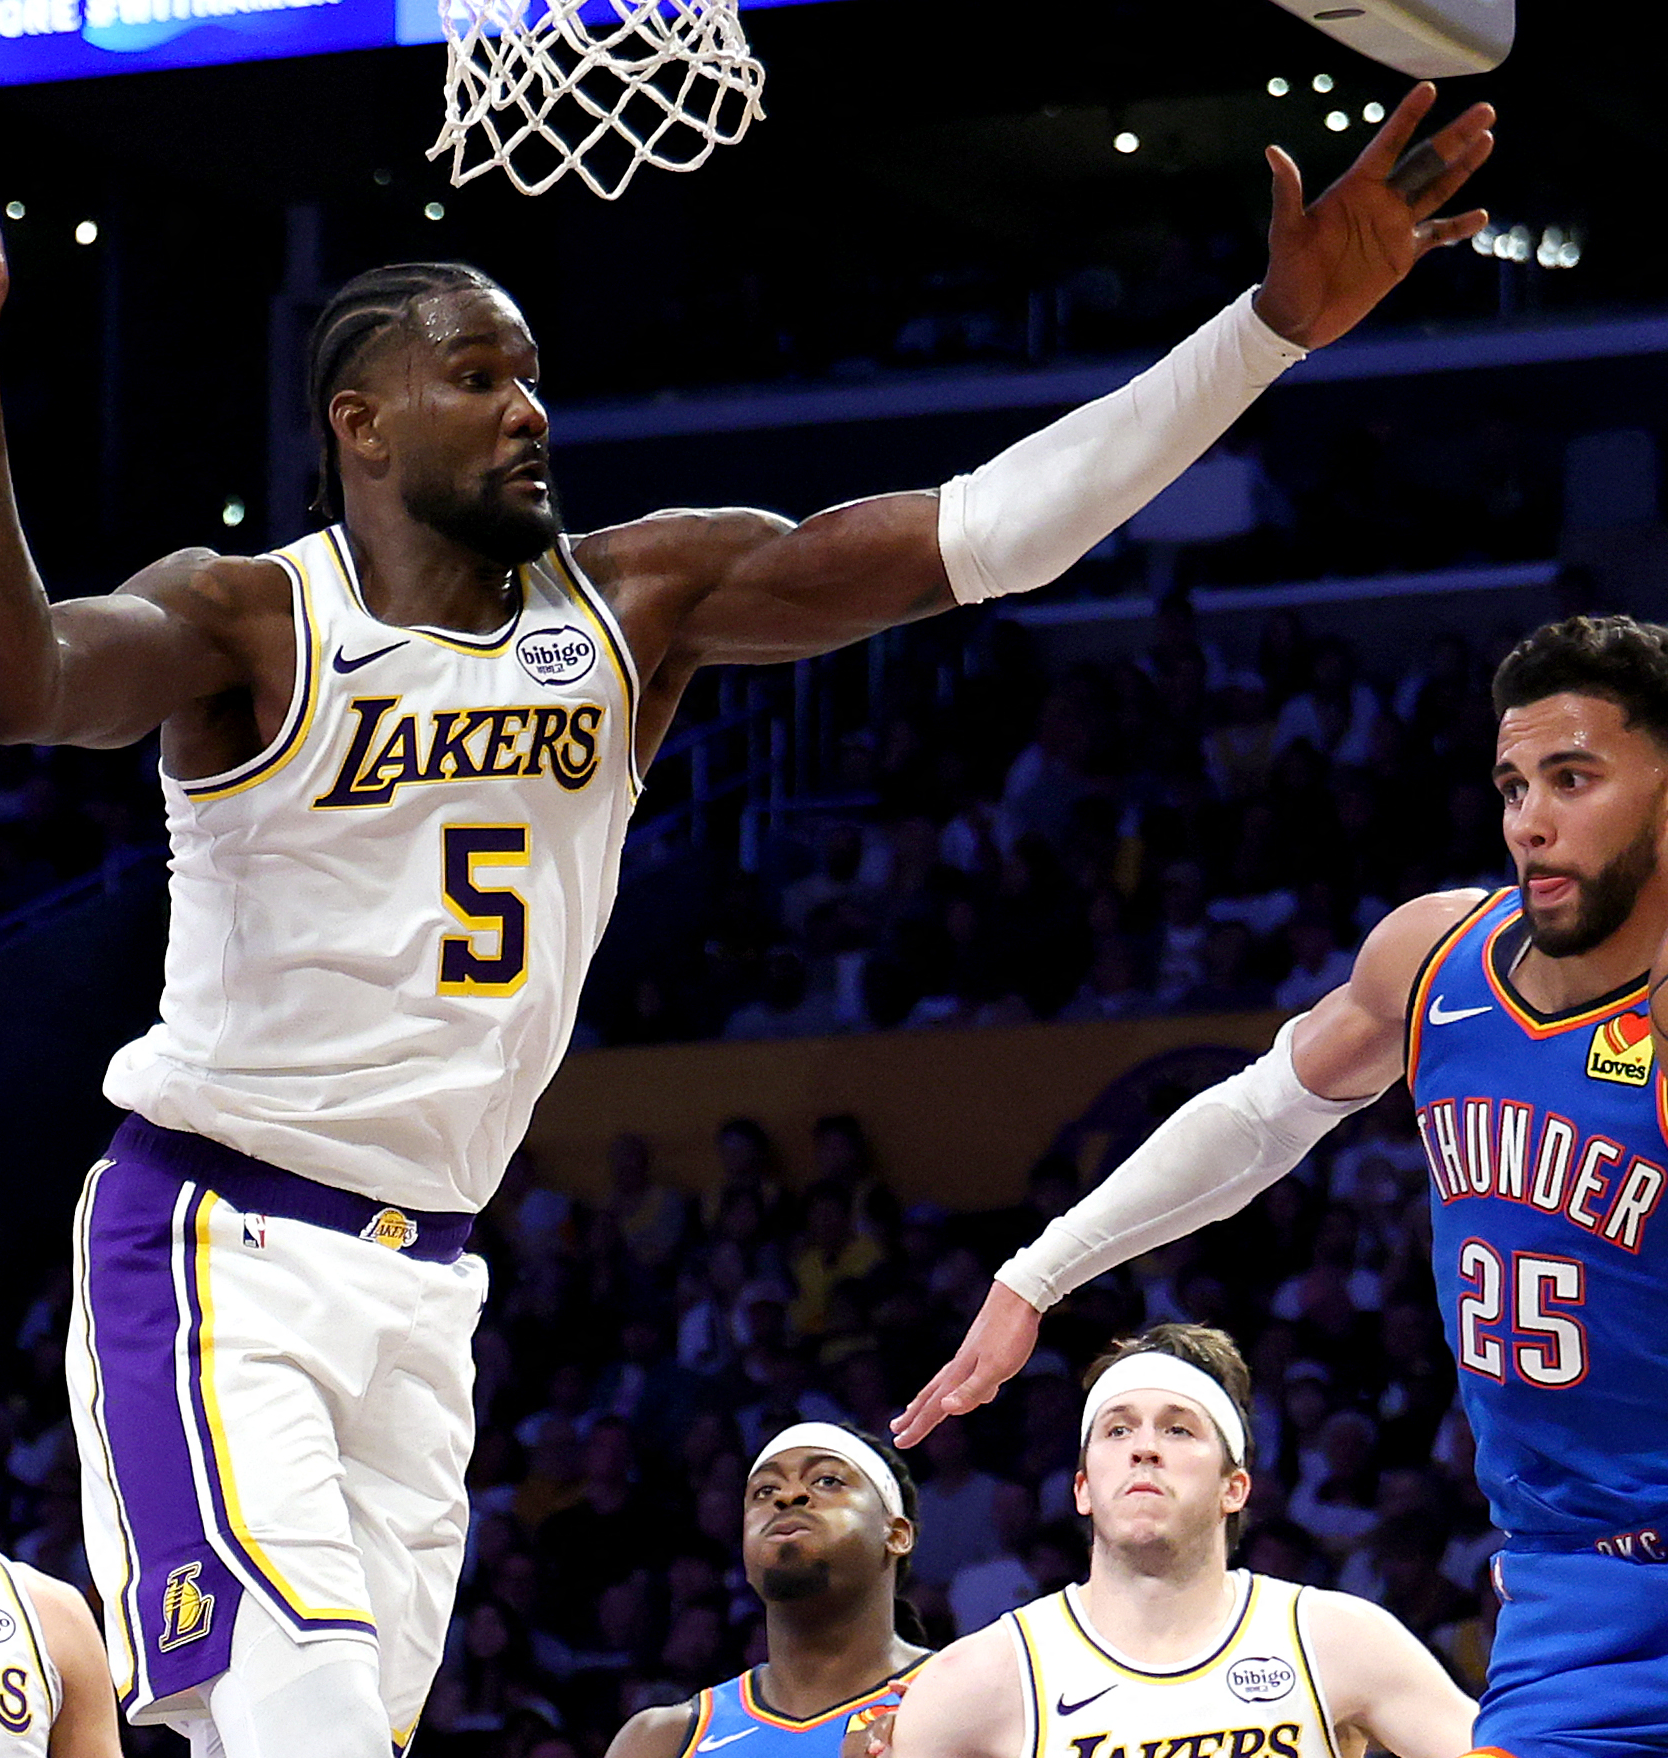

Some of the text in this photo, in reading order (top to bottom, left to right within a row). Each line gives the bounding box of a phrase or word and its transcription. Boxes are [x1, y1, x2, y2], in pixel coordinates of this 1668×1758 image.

[521, 643, 589, 666] bibigo
[309, 695, 605, 810] LAKERS
[437, 823, 530, 997] 5
[1417, 1097, 1666, 1254] THUNDER
[1458, 1236, 1589, 1389] 25
[1233, 1669, 1291, 1688] bibigo
